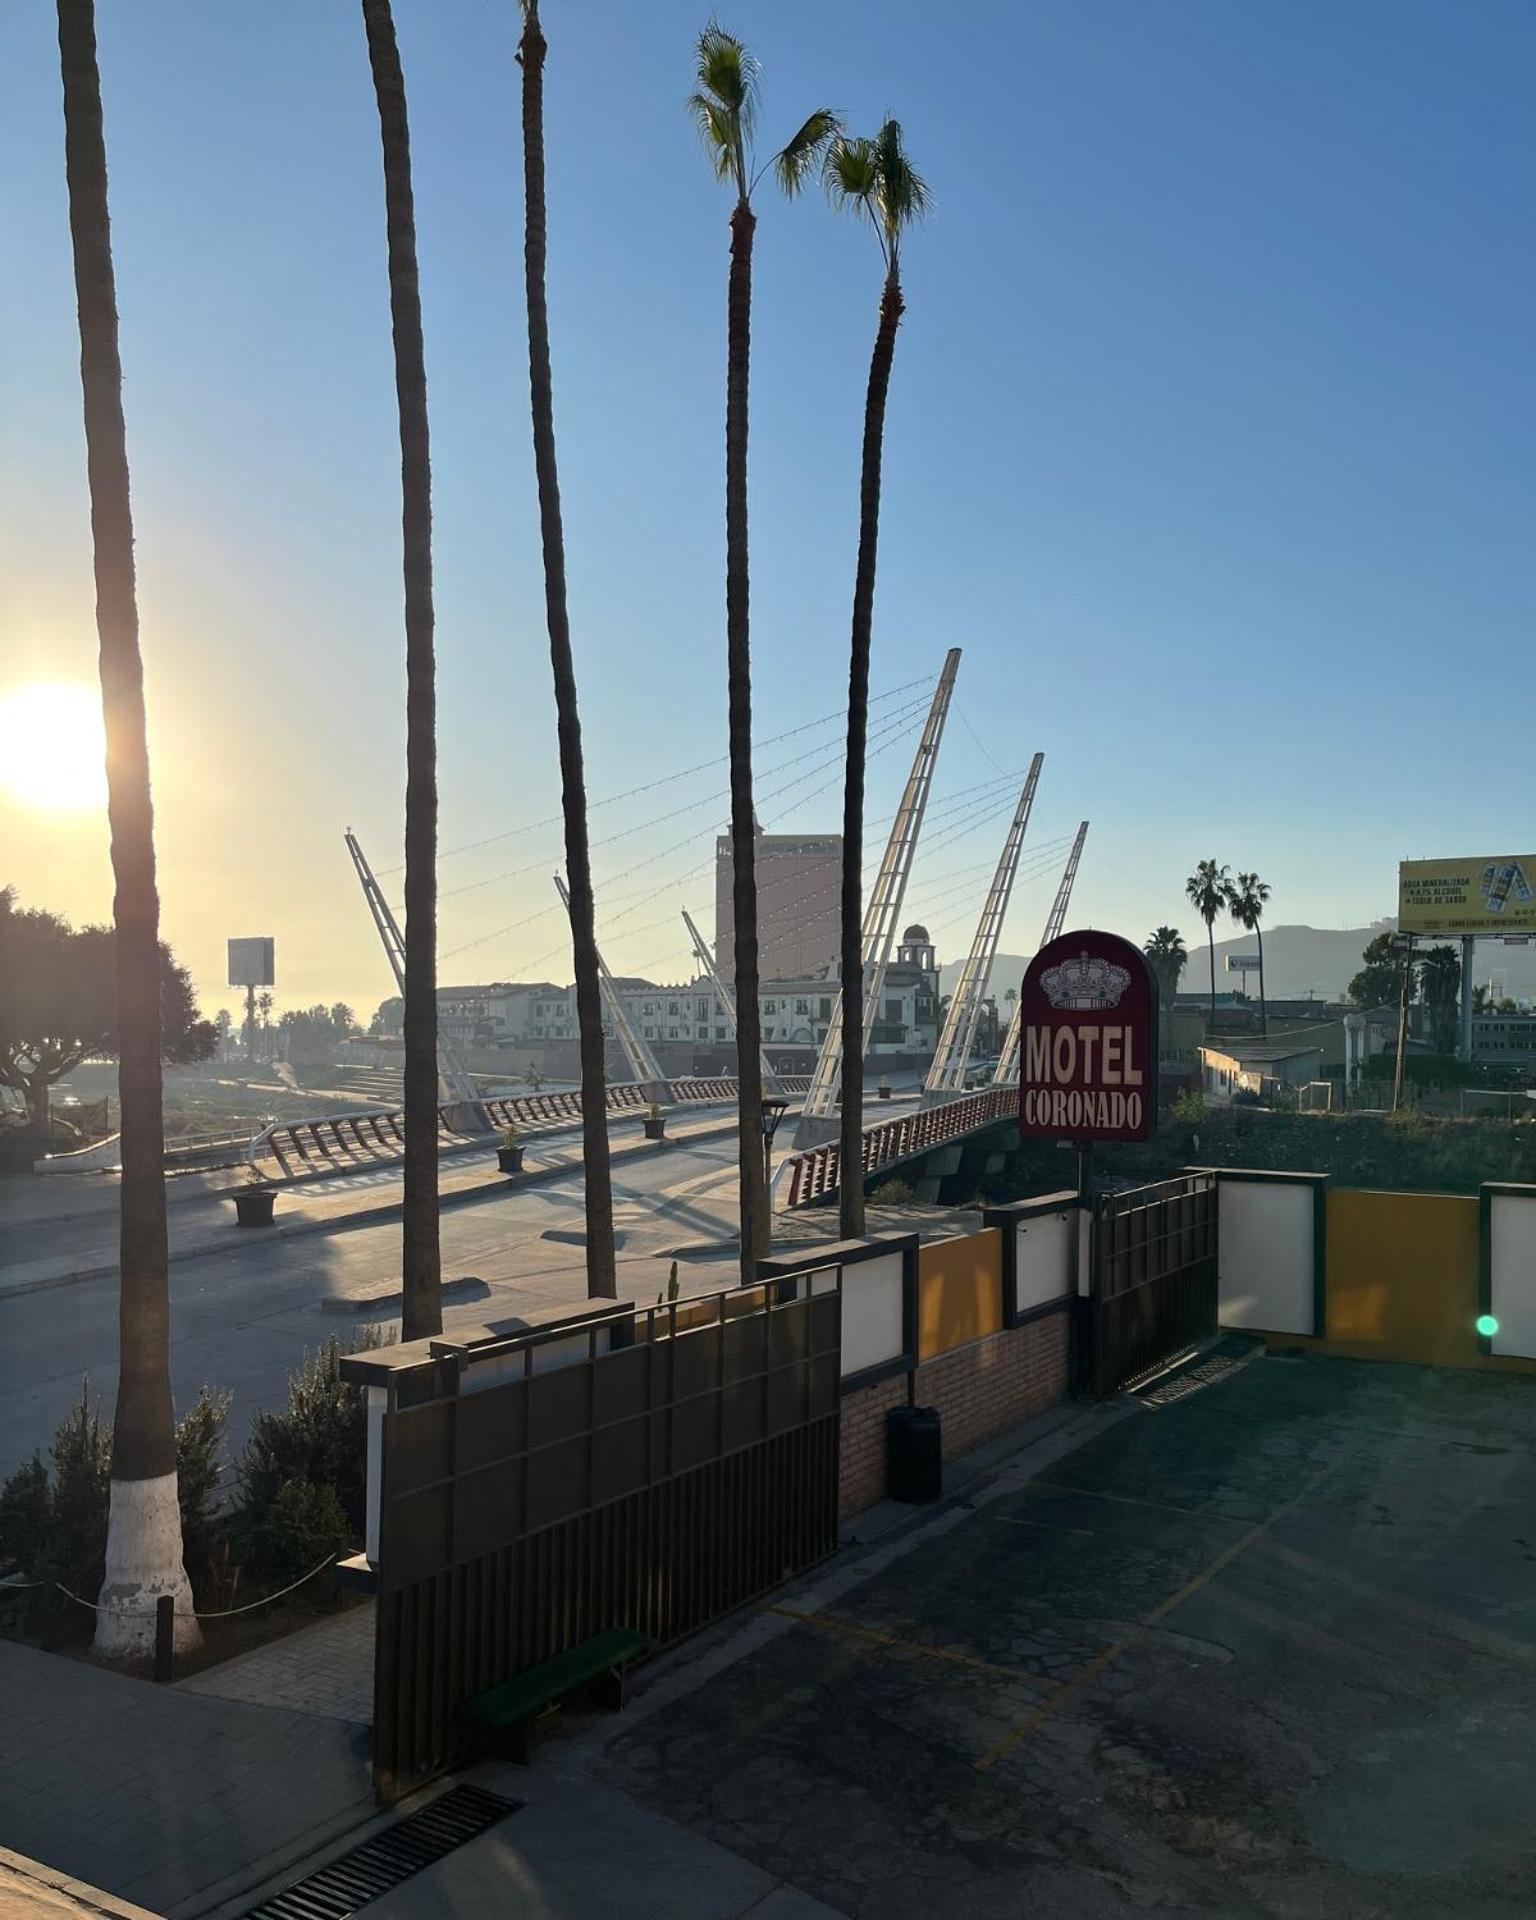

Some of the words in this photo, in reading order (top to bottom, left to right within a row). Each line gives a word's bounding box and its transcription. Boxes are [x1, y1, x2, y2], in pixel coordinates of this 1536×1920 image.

[1404, 879, 1420, 888] AGUA
[1422, 878, 1470, 887] MINERALIZADA
[1026, 1025, 1143, 1085] MOTEL
[1025, 1089, 1143, 1130] CORONADO
